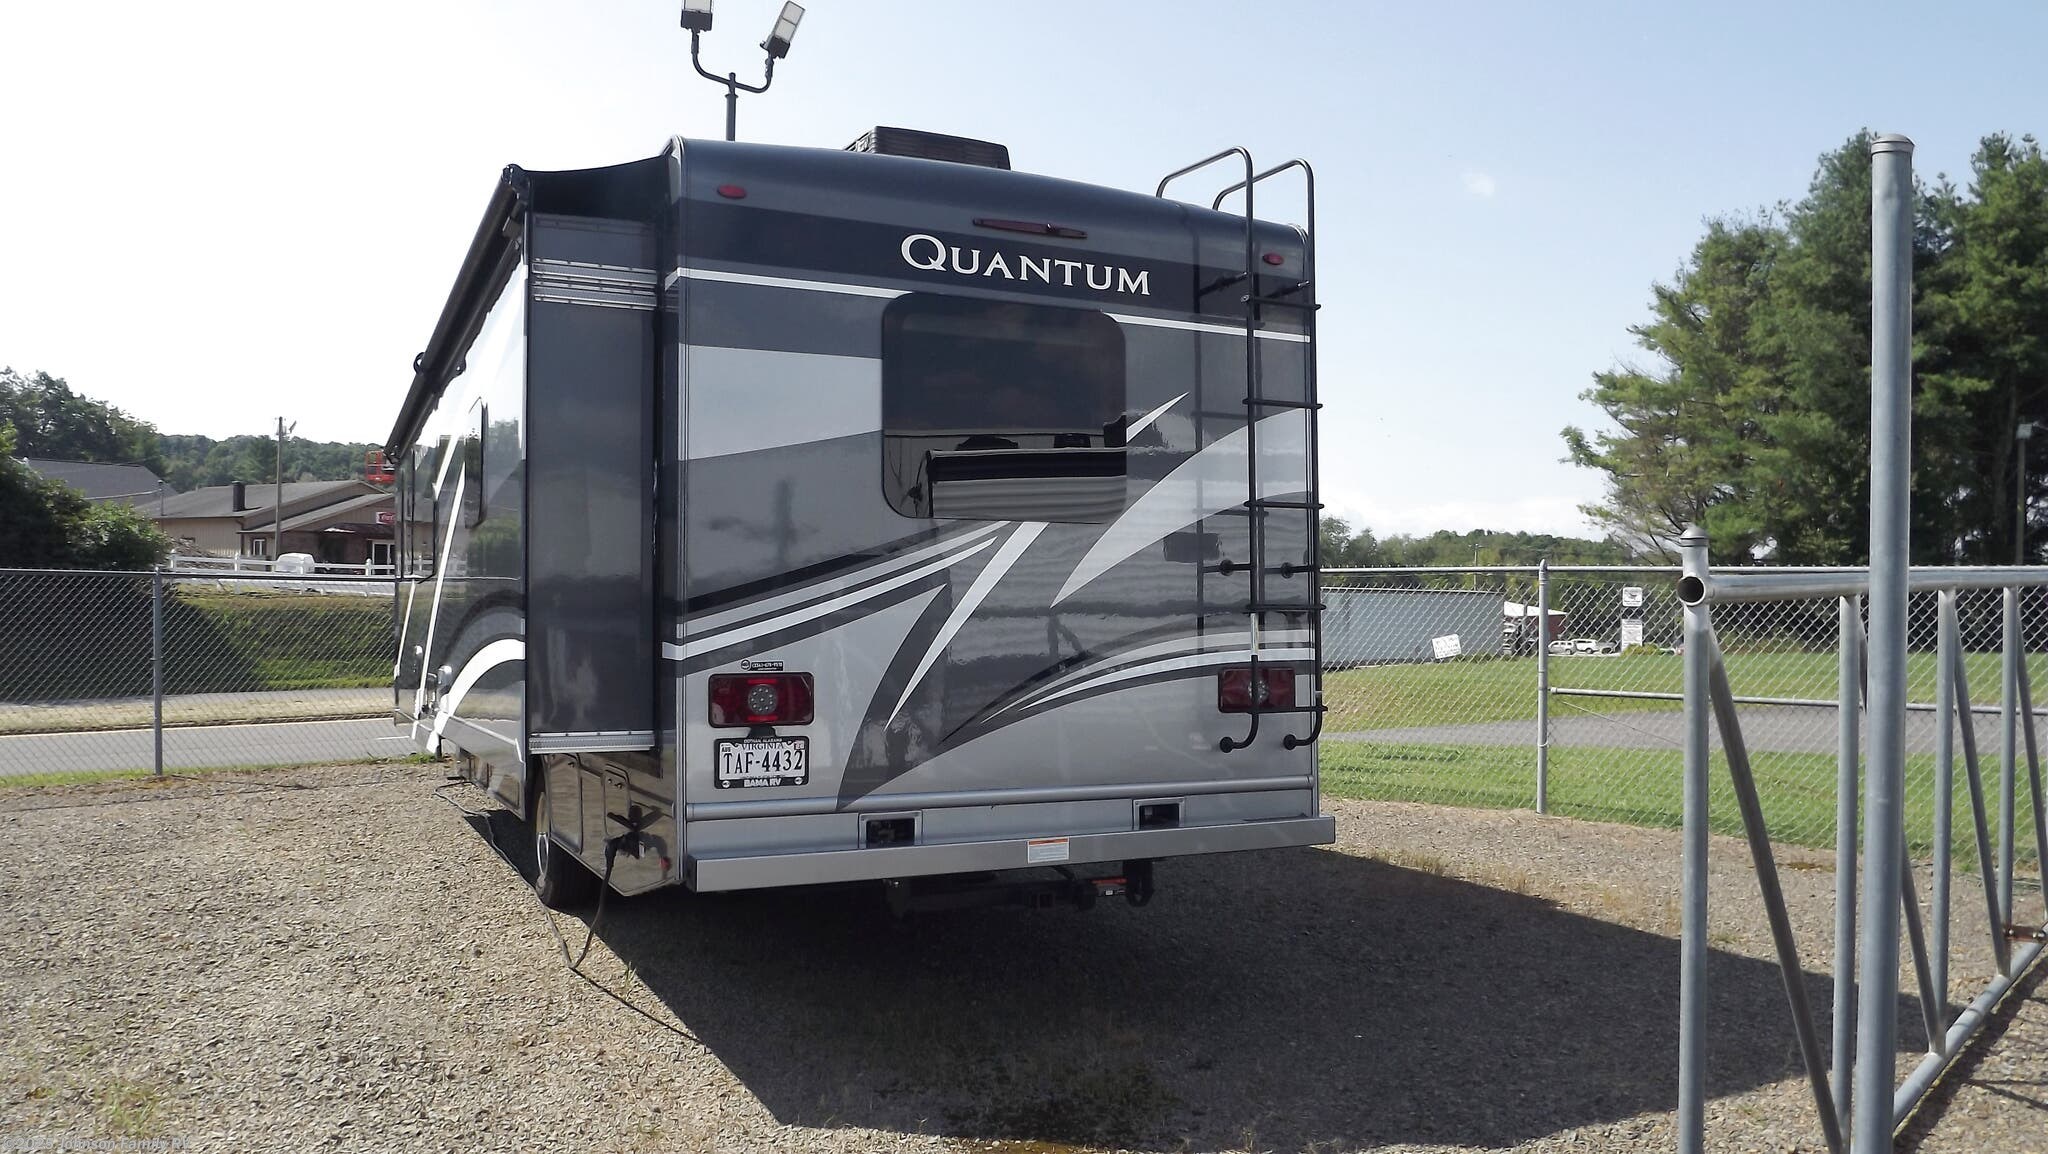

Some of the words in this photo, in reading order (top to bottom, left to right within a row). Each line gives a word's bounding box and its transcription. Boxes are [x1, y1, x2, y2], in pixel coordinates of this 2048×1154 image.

[901, 234, 1151, 296] QUANTUM
[742, 743, 785, 751] VIRGINIA
[723, 750, 803, 774] TAF-4432
[744, 779, 768, 787] BAMA
[770, 778, 782, 786] RV
